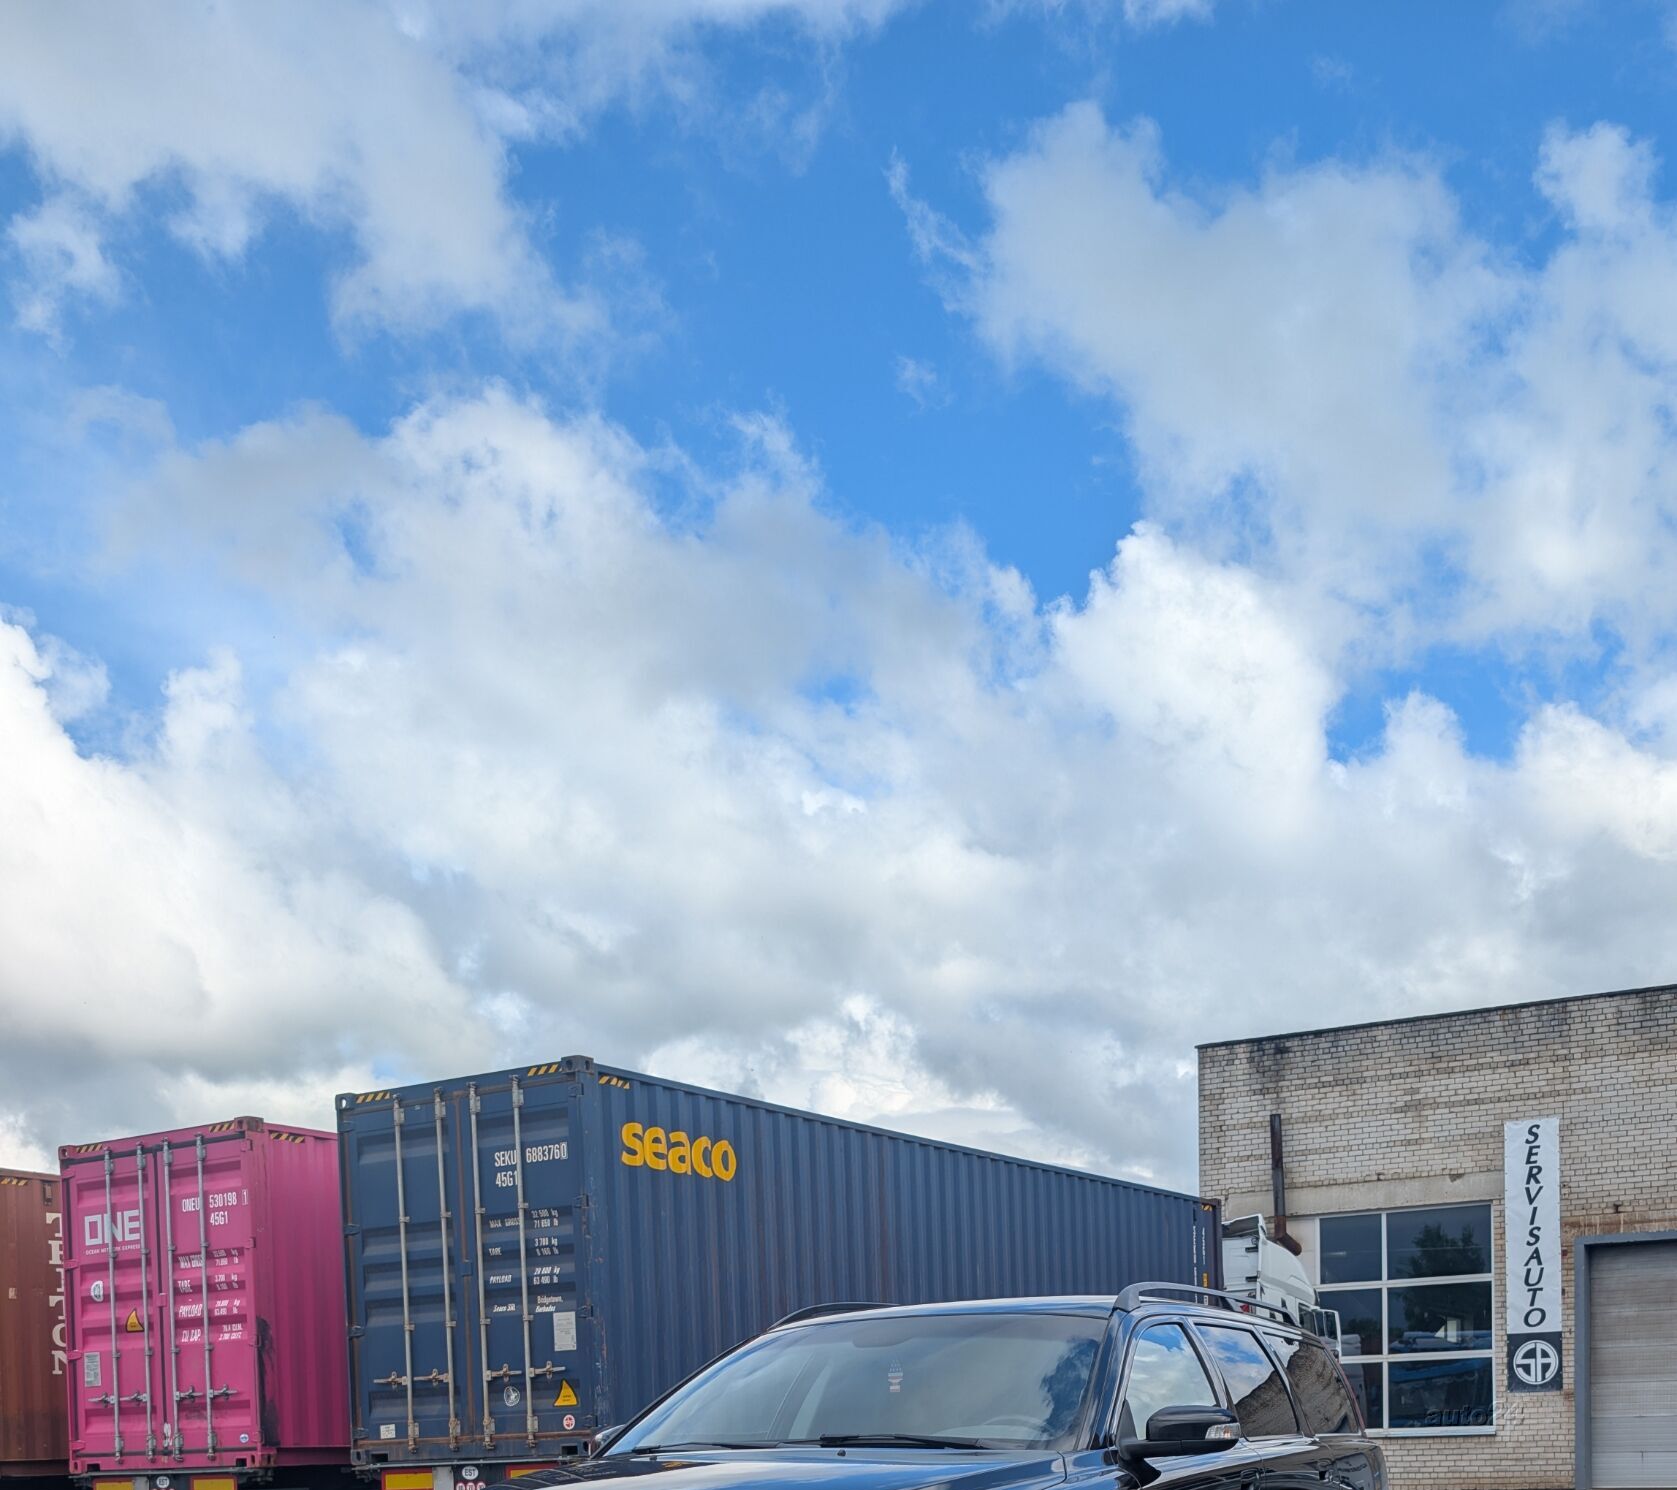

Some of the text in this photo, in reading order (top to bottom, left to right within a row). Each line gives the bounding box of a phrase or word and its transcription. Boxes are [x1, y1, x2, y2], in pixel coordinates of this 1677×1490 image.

[494, 1149, 518, 1167] SEKU
[495, 1170, 518, 1187] 45G1
[182, 1197, 201, 1212] ONEU
[209, 1191, 237, 1208] 530198
[210, 1211, 228, 1226] 45G1
[1523, 1123, 1547, 1328] SERVISAUTO
[84, 1209, 141, 1246] ONE
[179, 1303, 203, 1318] PAYLOAD
[464, 1468, 476, 1477] EST
